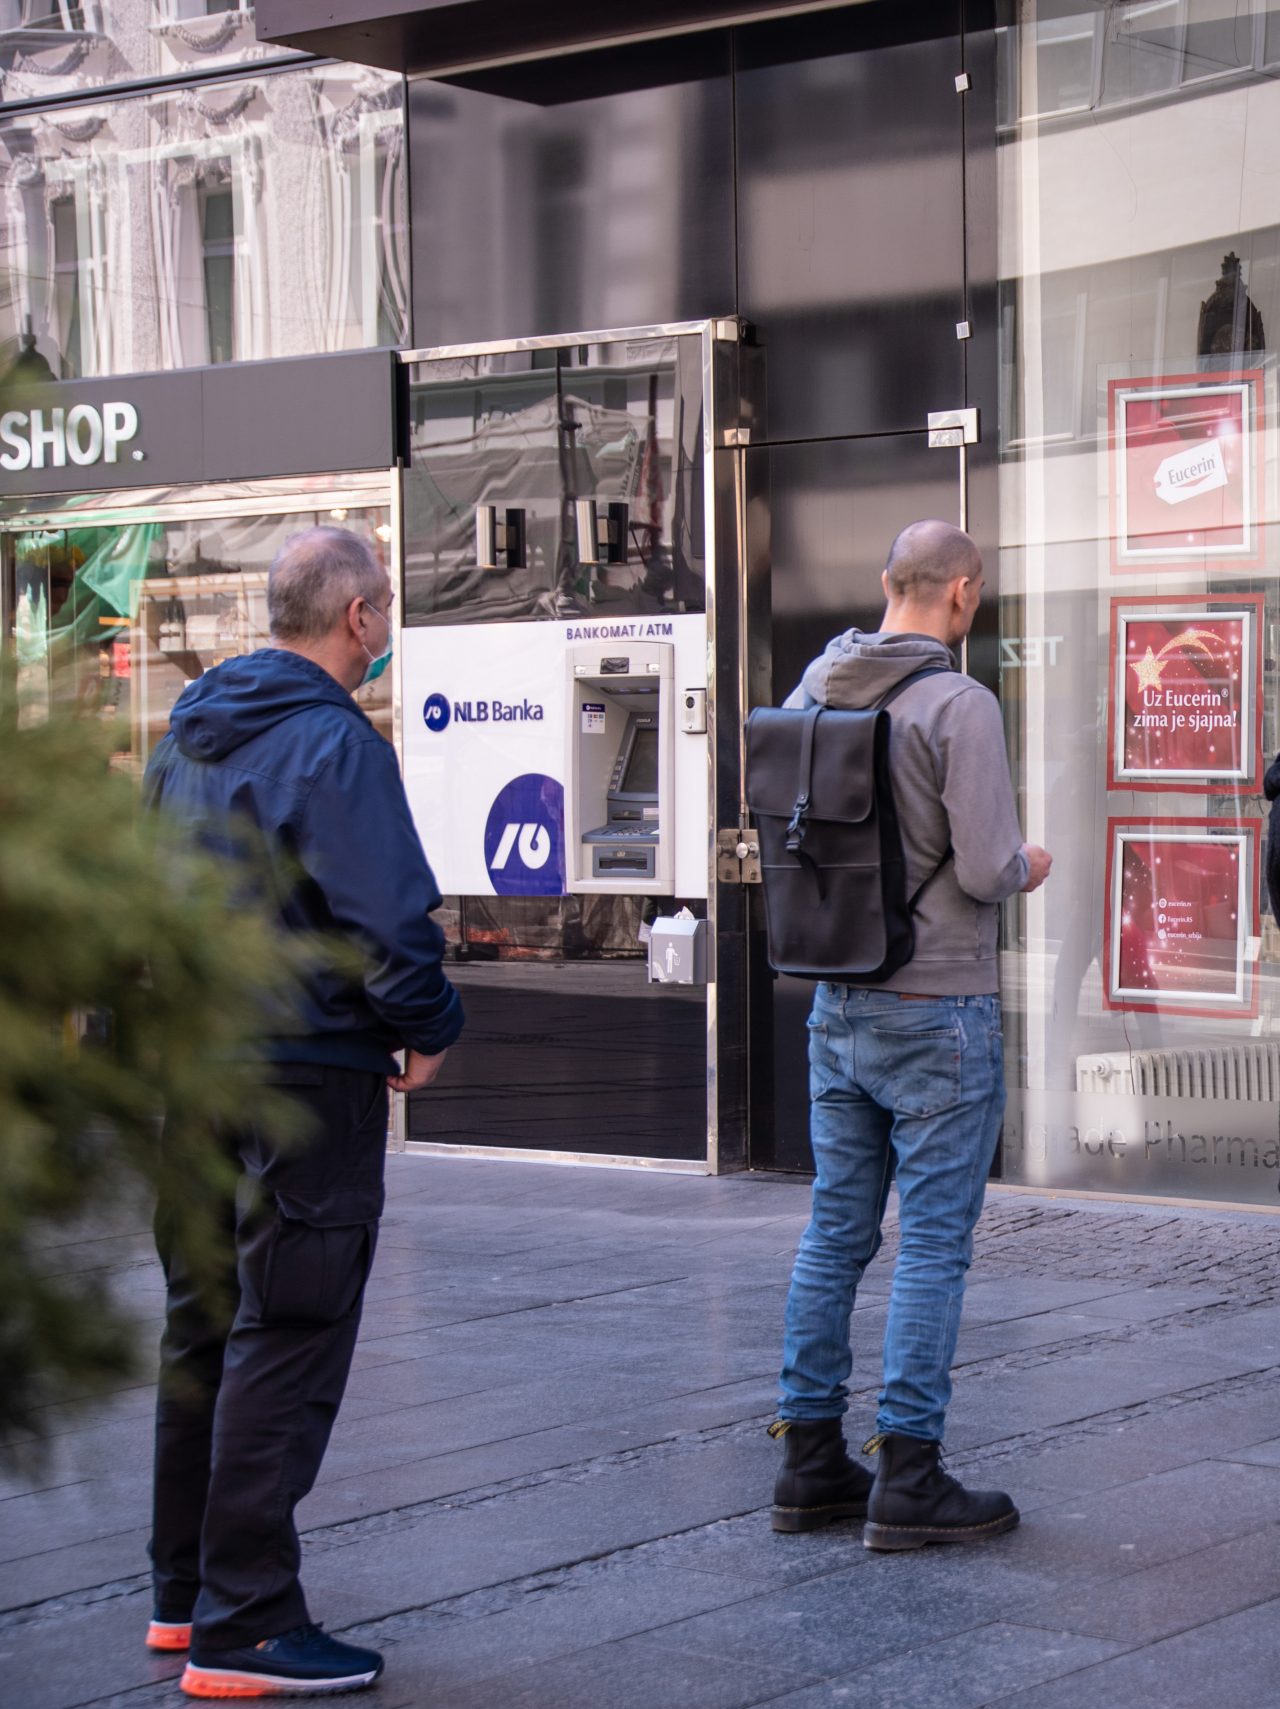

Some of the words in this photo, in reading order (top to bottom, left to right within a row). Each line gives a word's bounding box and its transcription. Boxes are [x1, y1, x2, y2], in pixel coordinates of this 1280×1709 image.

[1167, 457, 1216, 486] Eucerin
[566, 624, 636, 640] BANKOMAT
[646, 623, 673, 636] ATM
[454, 701, 489, 722] NLB
[492, 698, 544, 721] Banka
[1143, 689, 1163, 707] Uz
[1133, 709, 1168, 727] zima
[1170, 709, 1186, 733] je
[1188, 709, 1237, 733] sjajna!
